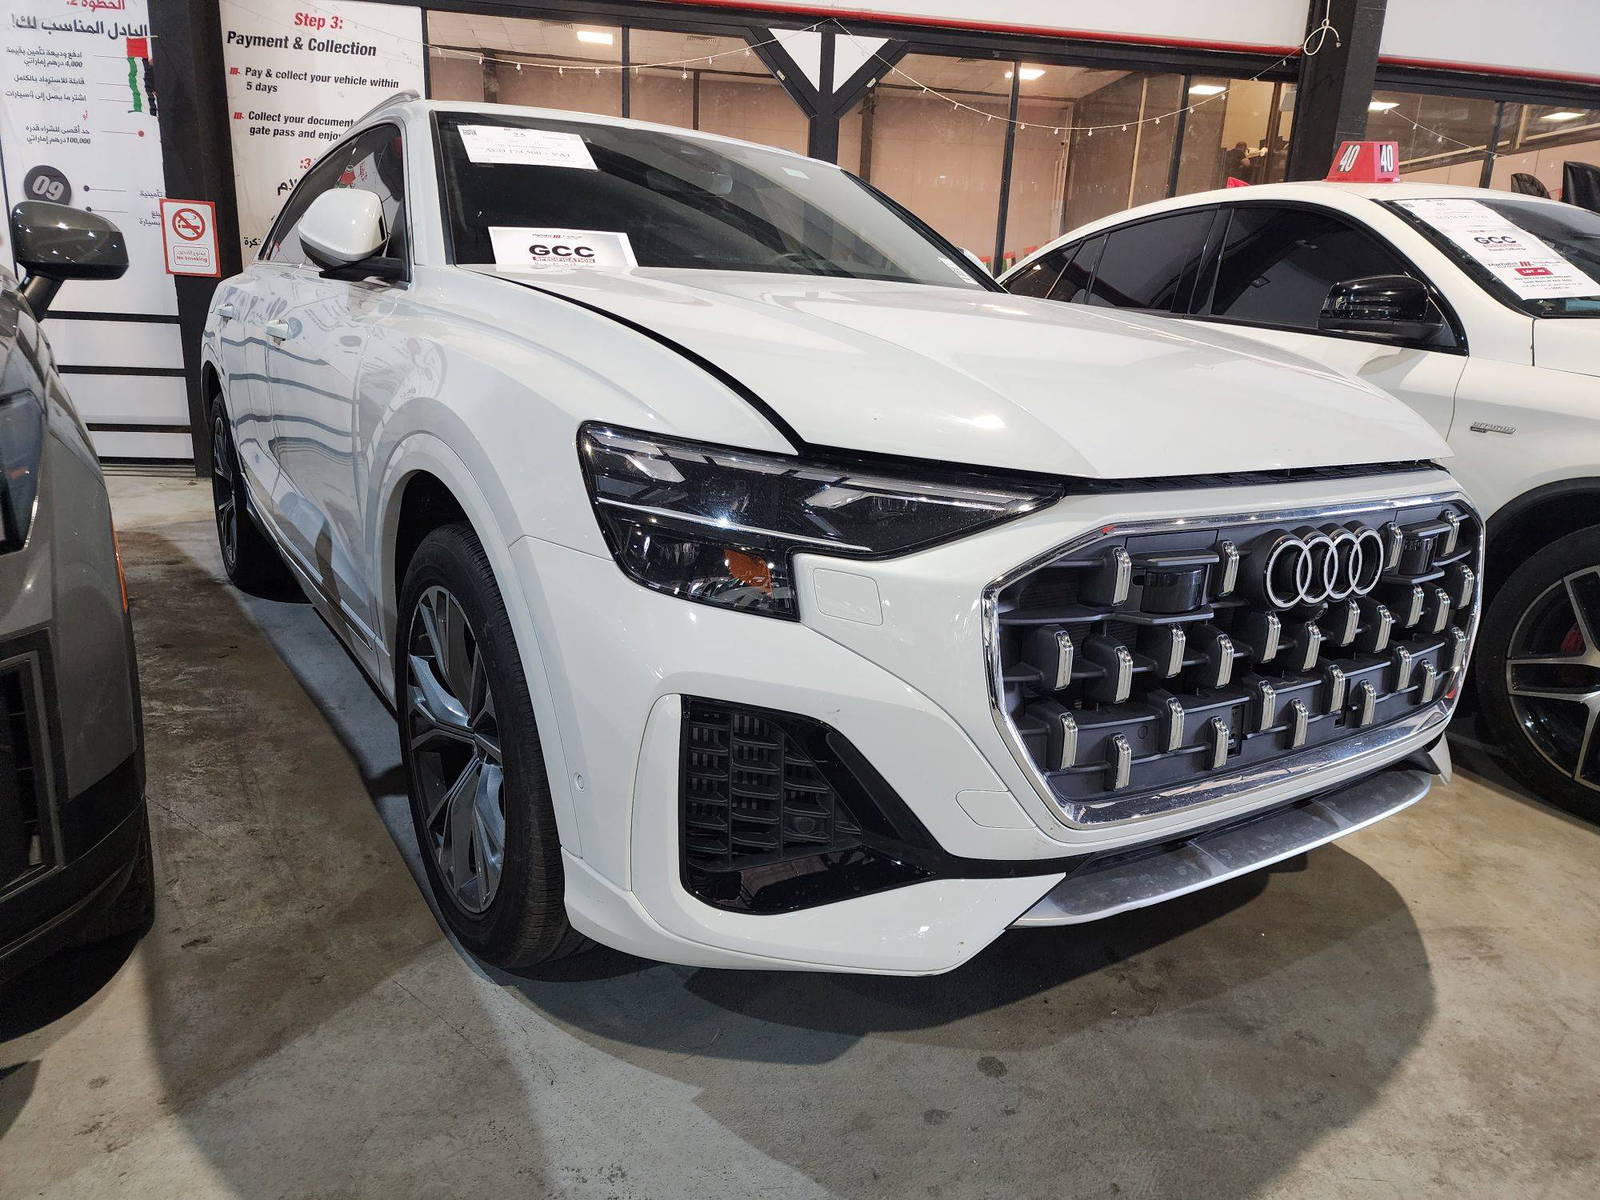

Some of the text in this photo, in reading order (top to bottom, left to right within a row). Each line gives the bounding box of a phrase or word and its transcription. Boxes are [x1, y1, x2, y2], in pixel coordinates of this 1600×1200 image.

[41, 19, 104, 35] المناسب
[294, 12, 343, 30] Step 3:
[226, 30, 377, 57] Payment & Collection
[244, 66, 399, 89] Pay & collect your vehicle within
[246, 81, 278, 93] 5 days
[248, 111, 354, 127] Collect your document
[249, 125, 271, 136] gate
[273, 127, 295, 137] pass
[298, 129, 316, 139] and
[1338, 145, 1360, 172] 40
[1380, 144, 1394, 172] 40
[1474, 235, 1517, 245] GCC
[529, 244, 595, 257] GCC
